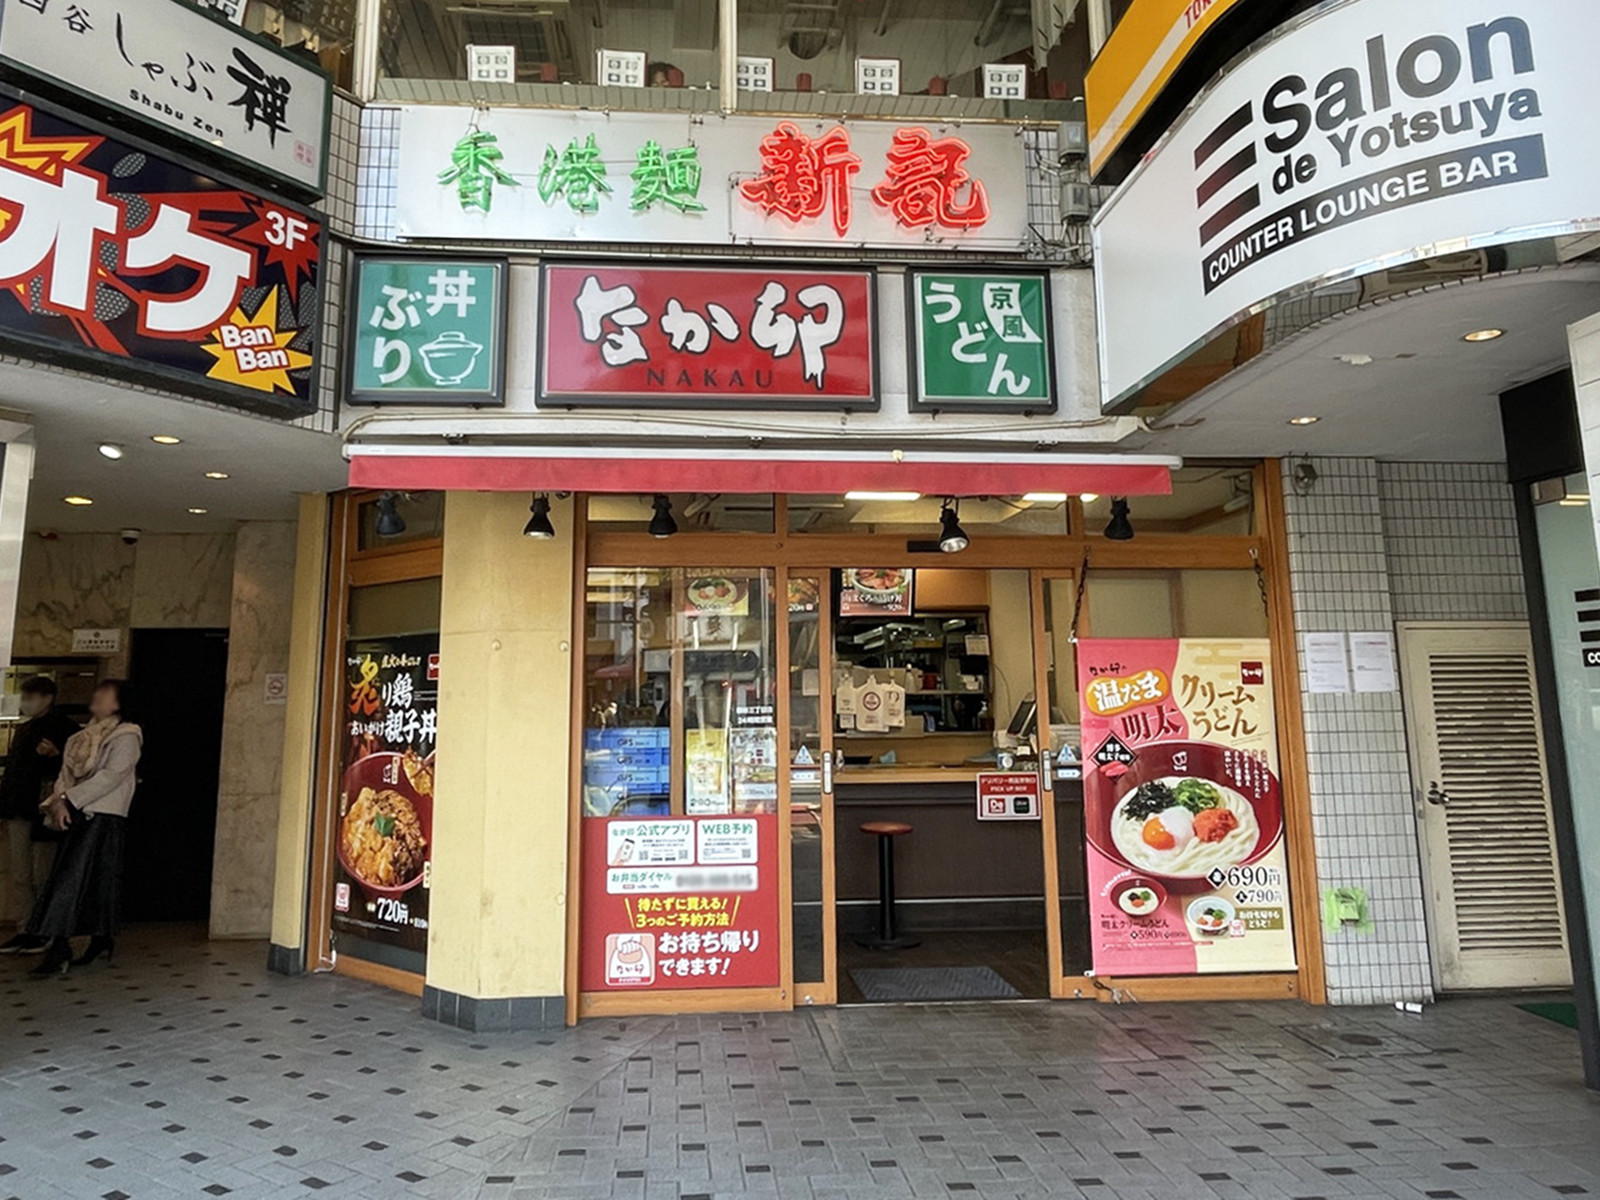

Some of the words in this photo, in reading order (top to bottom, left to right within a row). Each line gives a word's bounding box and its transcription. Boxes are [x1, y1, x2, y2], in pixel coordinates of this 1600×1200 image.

[1262, 16, 1535, 154] Salon
[129, 89, 184, 121] Shabu
[193, 116, 224, 138] Zen
[1272, 153, 1317, 195] de
[1327, 88, 1542, 168] Yotsuya
[264, 210, 308, 252] 3F
[1209, 216, 1295, 283] COUNTER
[1300, 169, 1430, 230] LOUNGE
[1439, 151, 1519, 188] BAR
[221, 325, 274, 349] Ban
[574, 275, 845, 391] なか卯
[925, 281, 1036, 395] うどん
[237, 346, 289, 372] Ban
[646, 369, 773, 388] NAKAU
[1094, 671, 1162, 711] 温たま
[1182, 674, 1255, 709] クリーム
[1121, 705, 1183, 745] 明太
[1193, 705, 1258, 739] うどん
[658, 930, 759, 954] お持ち帰り
